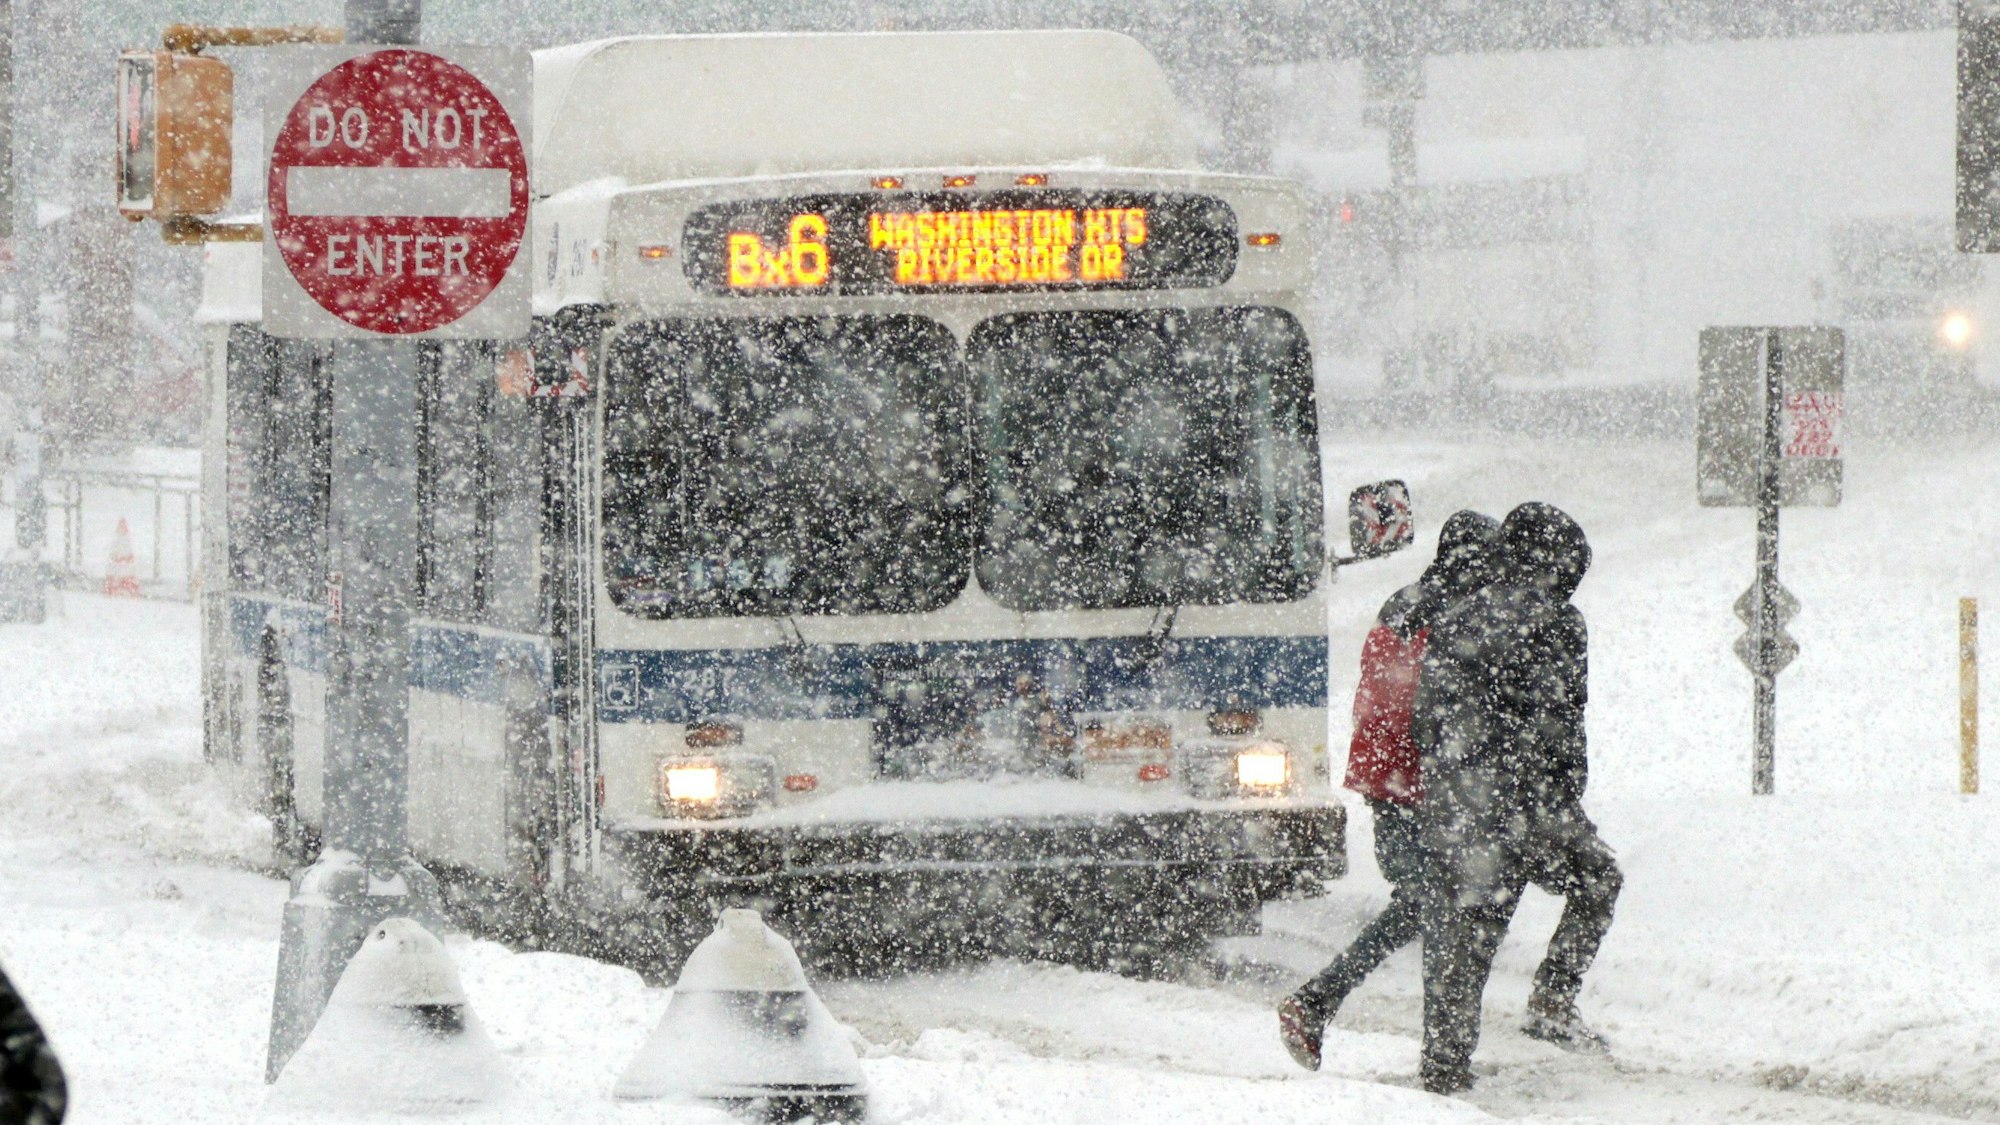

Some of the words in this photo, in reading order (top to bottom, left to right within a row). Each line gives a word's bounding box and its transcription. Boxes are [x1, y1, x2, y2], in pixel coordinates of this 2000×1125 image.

[308, 106, 369, 149] DO
[402, 107, 488, 150] NOT
[728, 212, 830, 287] Bx6
[869, 209, 1075, 250] WASHINGTON
[1082, 208, 1147, 246] HTS
[326, 234, 470, 277] ENTER
[895, 246, 1072, 284] RIVERSIDE
[1081, 244, 1124, 280] DR
